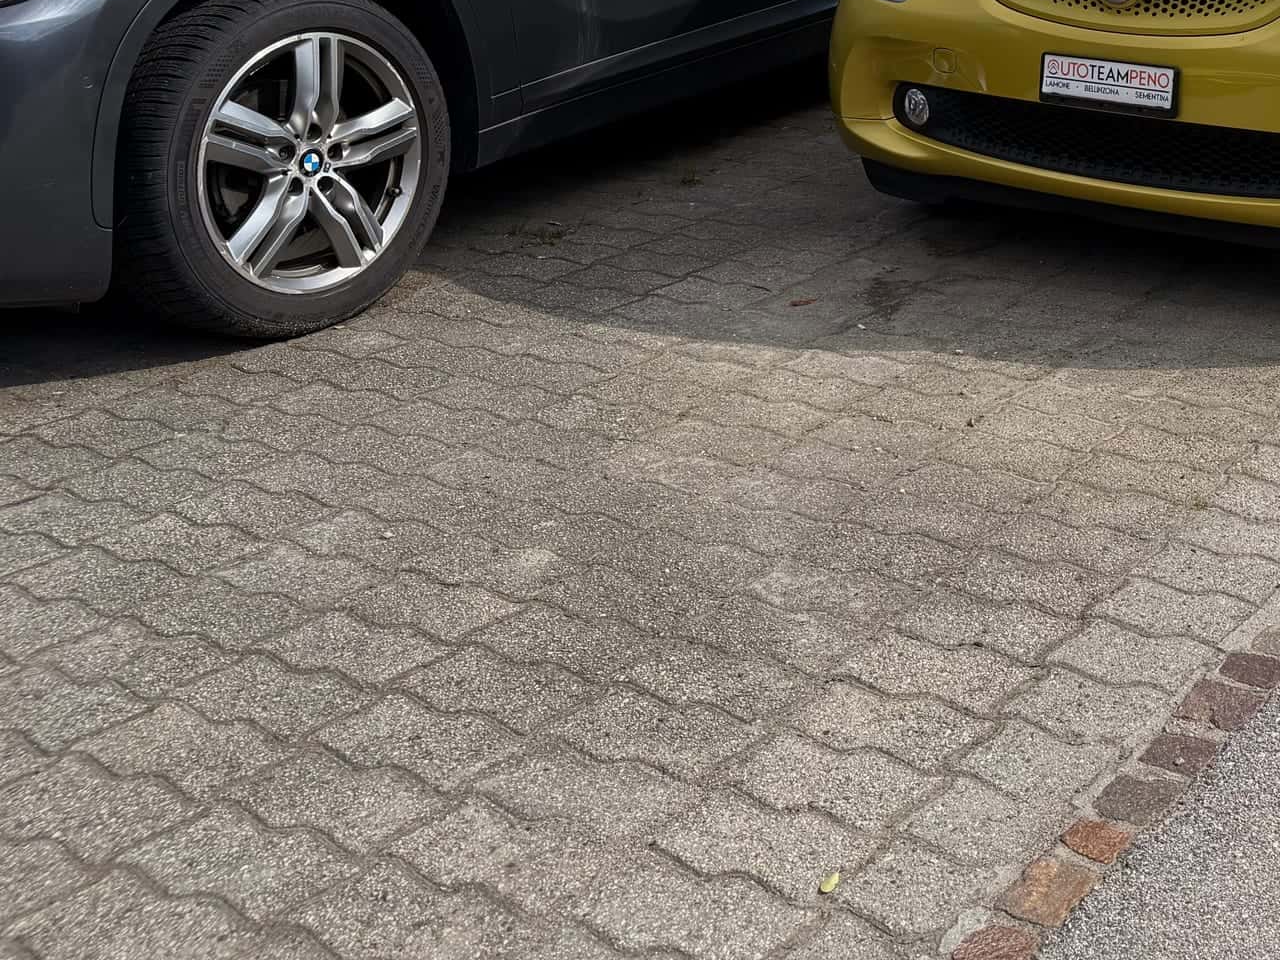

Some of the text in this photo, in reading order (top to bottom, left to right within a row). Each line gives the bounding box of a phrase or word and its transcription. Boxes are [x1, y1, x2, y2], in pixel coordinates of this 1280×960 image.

[1045, 79, 1169, 102] LAMONE BELLINZONA SEMENTINA
